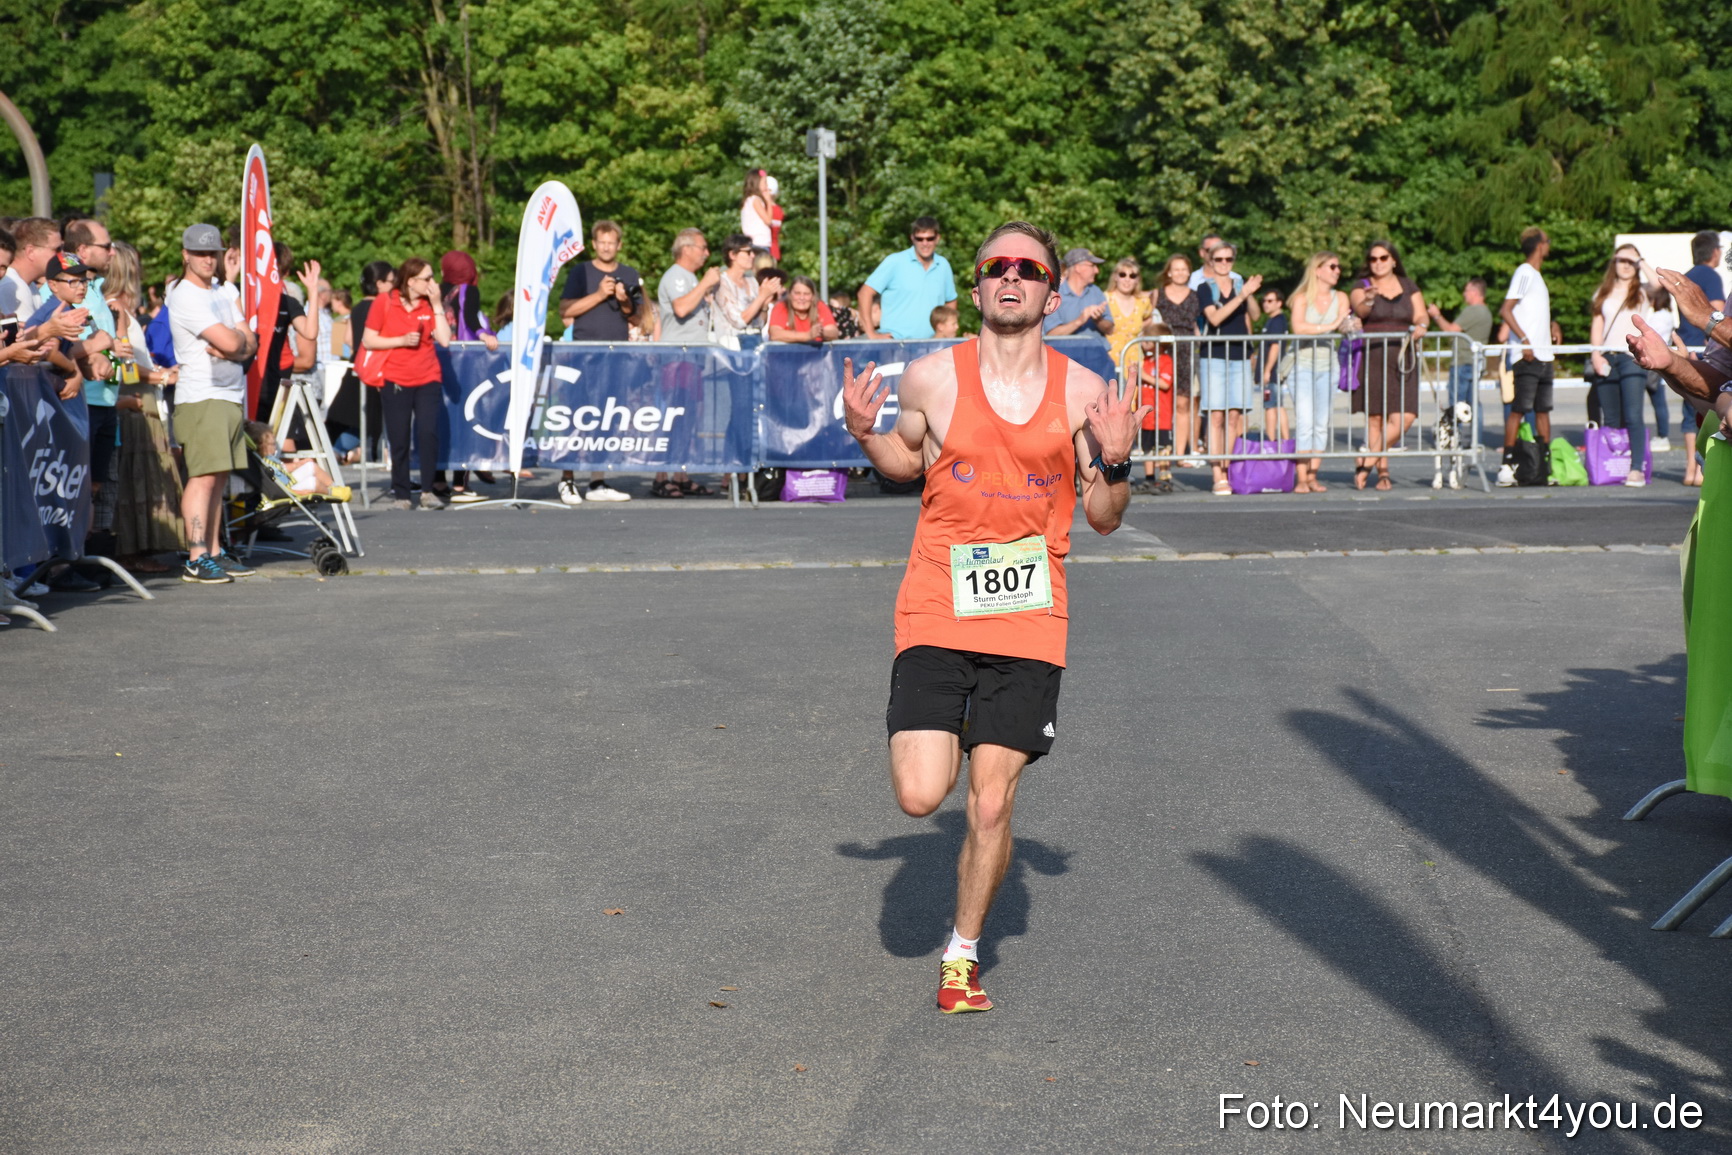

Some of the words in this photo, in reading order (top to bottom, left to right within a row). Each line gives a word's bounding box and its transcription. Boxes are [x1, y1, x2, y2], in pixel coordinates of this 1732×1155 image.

[537, 195, 552, 225] AVIA
[504, 397, 685, 432] ischer
[522, 436, 669, 452] AUTOMOBILE
[966, 556, 1004, 566] firmenlauf
[1026, 555, 1043, 564] 2019
[966, 563, 1037, 595] 1807
[973, 595, 996, 603] Sturm
[998, 591, 1034, 601] Christoph
